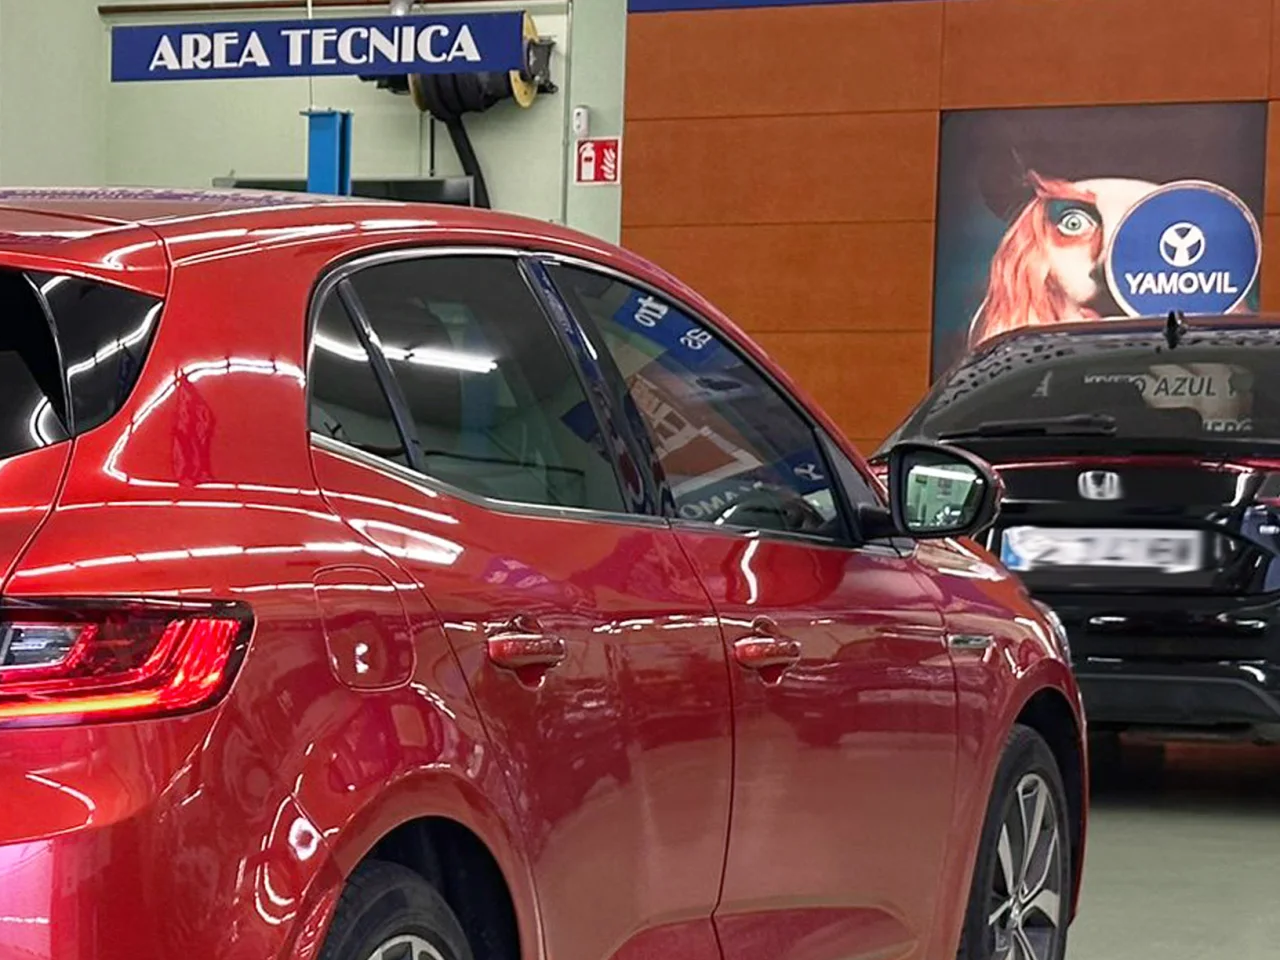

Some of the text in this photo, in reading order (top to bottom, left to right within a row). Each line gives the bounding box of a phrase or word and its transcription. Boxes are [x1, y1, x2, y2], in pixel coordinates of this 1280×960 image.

[149, 24, 481, 71] AREA TECNICA
[1125, 271, 1238, 295] YAMOVIL
[1153, 376, 1217, 397] AZUL
